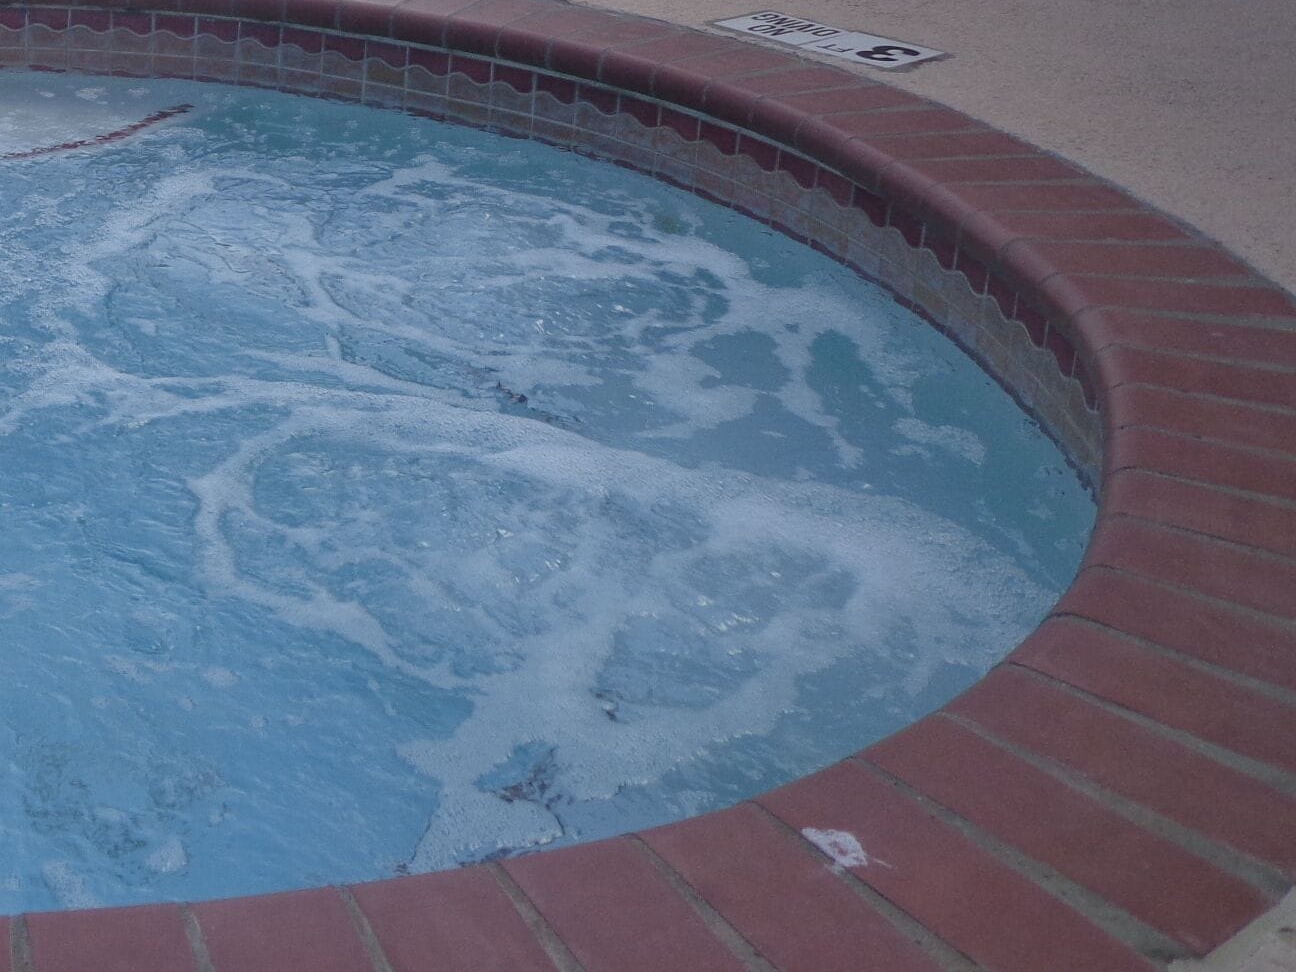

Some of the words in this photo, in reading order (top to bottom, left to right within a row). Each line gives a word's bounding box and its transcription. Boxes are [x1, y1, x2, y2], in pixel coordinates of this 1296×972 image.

[748, 24, 793, 37] NO
[751, 12, 842, 37] DIVING
[816, 42, 853, 53] FT
[855, 44, 921, 63] 3
